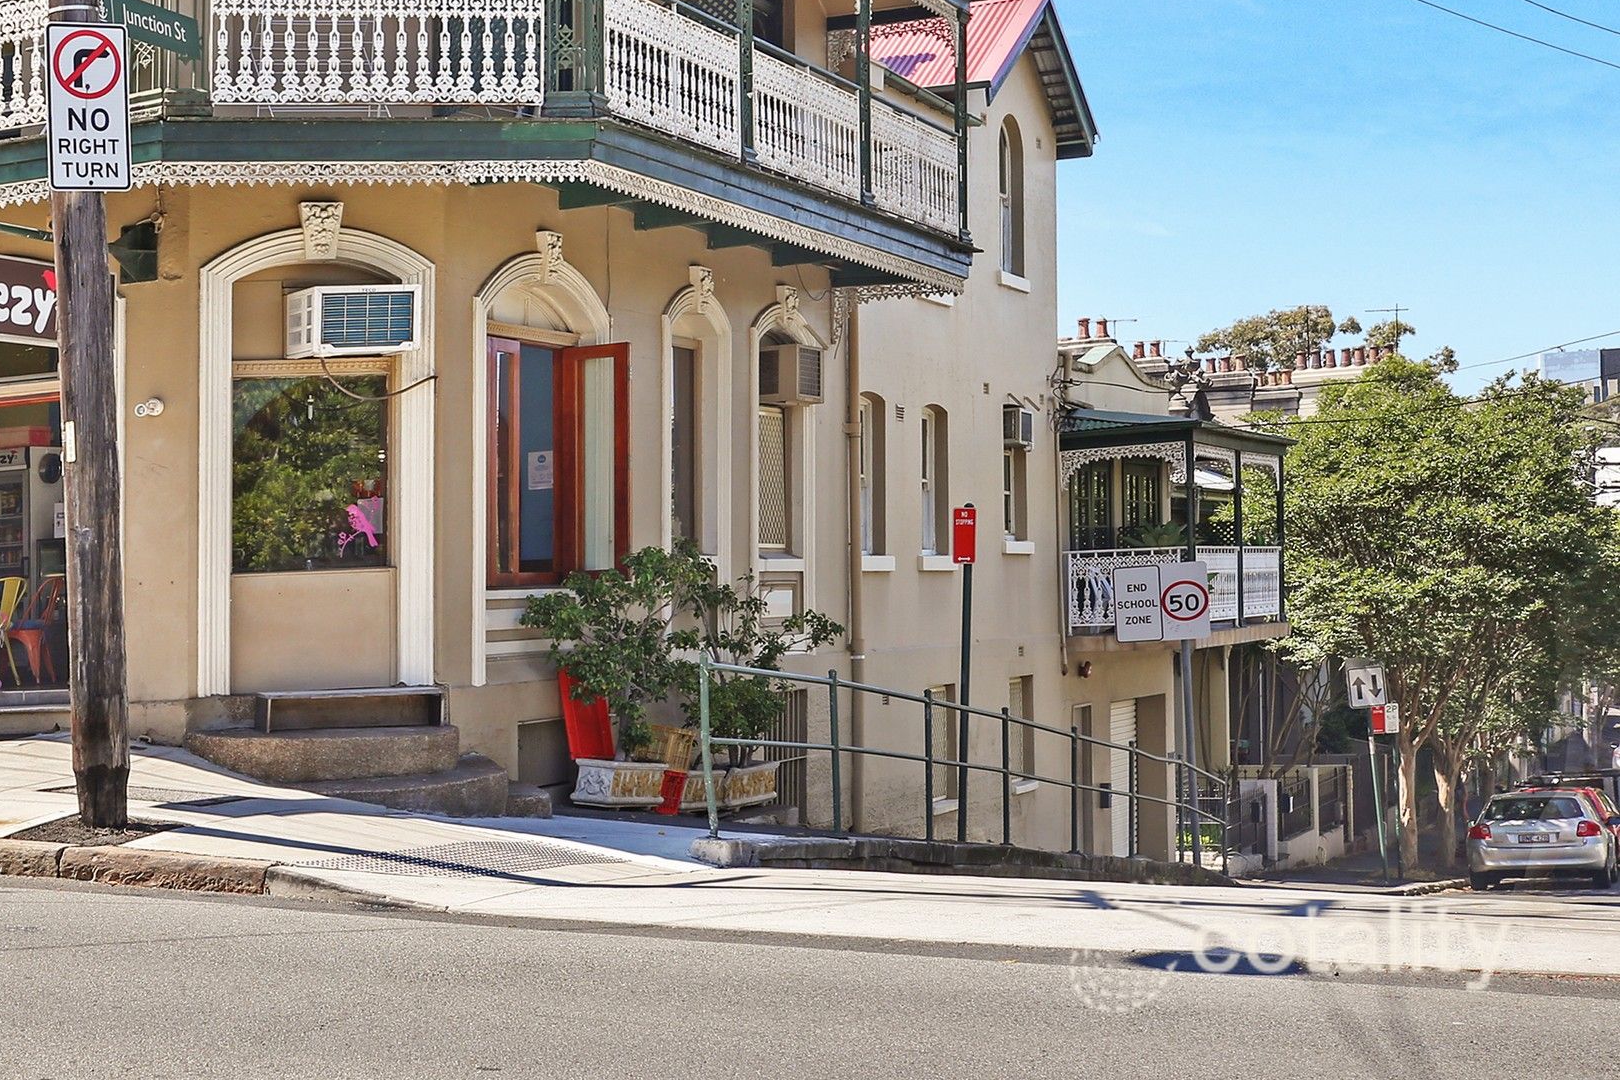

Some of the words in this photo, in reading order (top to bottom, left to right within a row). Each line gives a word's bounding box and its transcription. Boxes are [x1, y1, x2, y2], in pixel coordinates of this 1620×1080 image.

[122, 3, 172, 37] Junction
[173, 21, 187, 43] St
[68, 108, 110, 132] NO
[58, 138, 119, 155] RIGHT
[61, 162, 119, 178] TURN
[1126, 583, 1147, 593] END
[1117, 600, 1158, 610] SCHOOL
[1169, 593, 1199, 613] 50
[1125, 616, 1152, 626] ZONE
